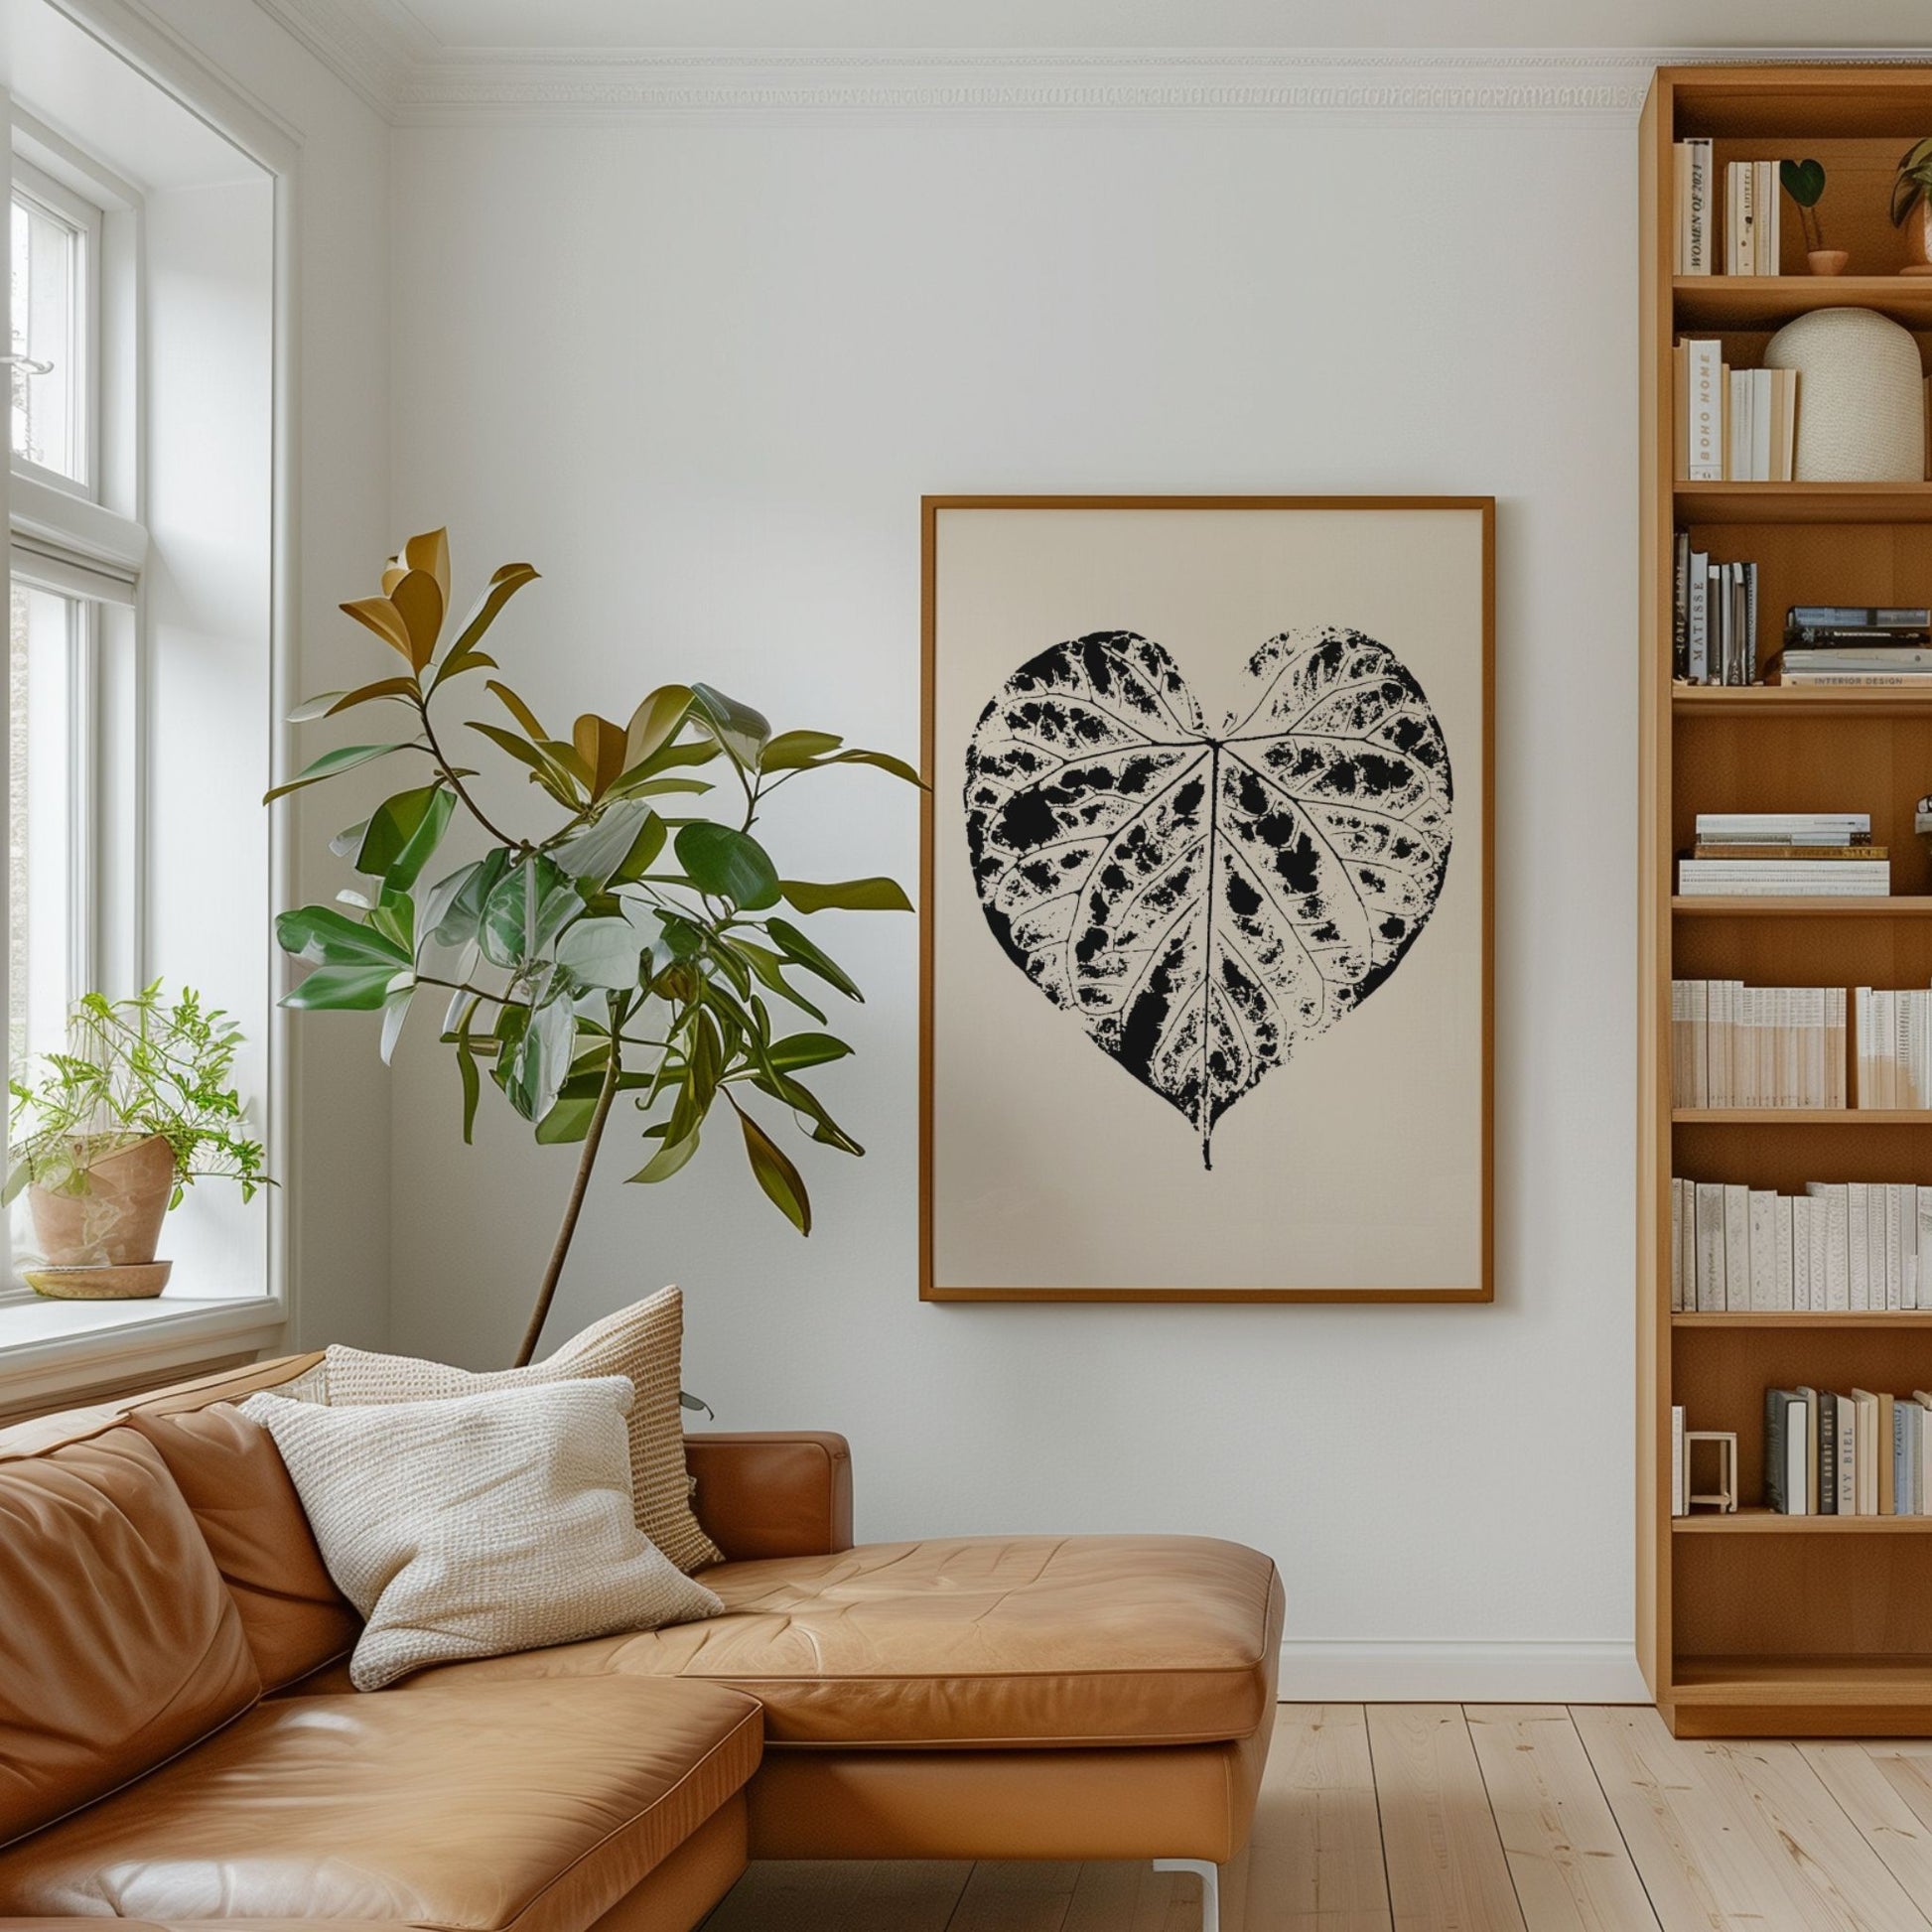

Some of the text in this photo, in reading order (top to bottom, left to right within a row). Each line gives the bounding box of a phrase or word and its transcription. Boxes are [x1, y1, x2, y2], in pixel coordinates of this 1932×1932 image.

[1691, 193, 1702, 212] OF
[1691, 214, 1702, 267] WOMEN
[1700, 354, 1710, 403] HOME
[1700, 412, 1710, 461] BOHO
[1693, 582, 1704, 661] MATISSE
[1843, 1428, 1854, 1502] IVY BIEL
[1823, 1484, 1833, 1503] ALL
